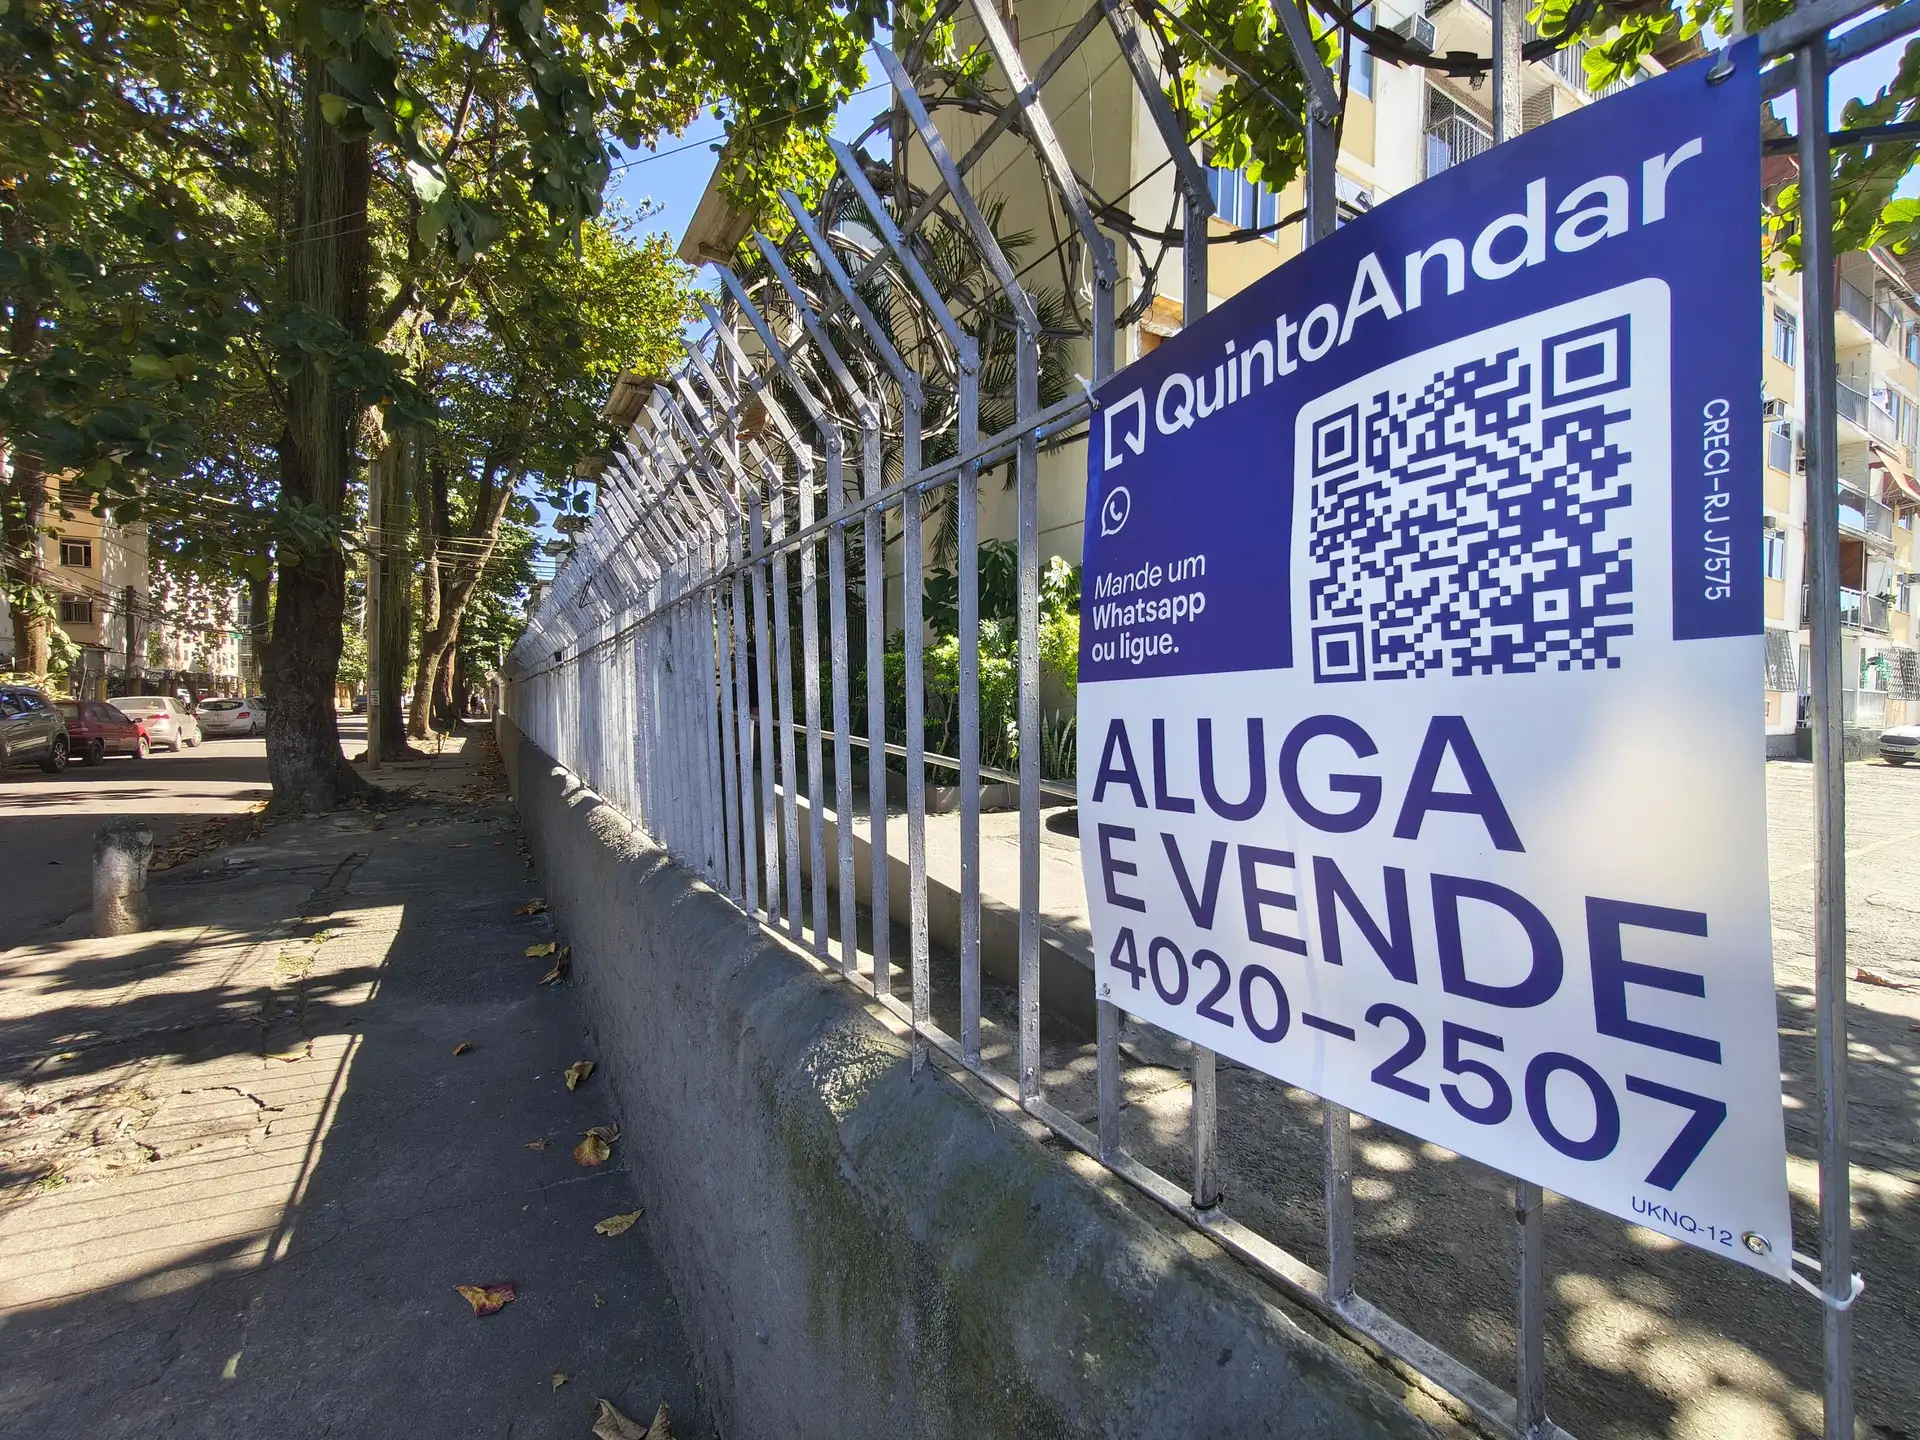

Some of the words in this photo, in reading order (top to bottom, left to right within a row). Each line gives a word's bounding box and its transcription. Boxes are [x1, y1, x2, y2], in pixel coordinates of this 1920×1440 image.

[1155, 137, 1702, 436] QuintoAndar
[1703, 398, 1730, 523] CRECI-RJ
[1092, 591, 1206, 631] Whatsapp
[1094, 561, 1162, 600] Mande
[1168, 554, 1206, 583] um
[1704, 529, 1731, 600] J7575
[1091, 641, 1115, 662] ou
[1120, 631, 1180, 665] ligue.
[1092, 715, 1525, 853] ALUGA
[1097, 822, 1146, 913] E
[1161, 833, 1722, 1064] VENDE
[1110, 926, 1728, 1192] 4020-2507
[1632, 1196, 1733, 1247] UKNQ-12
